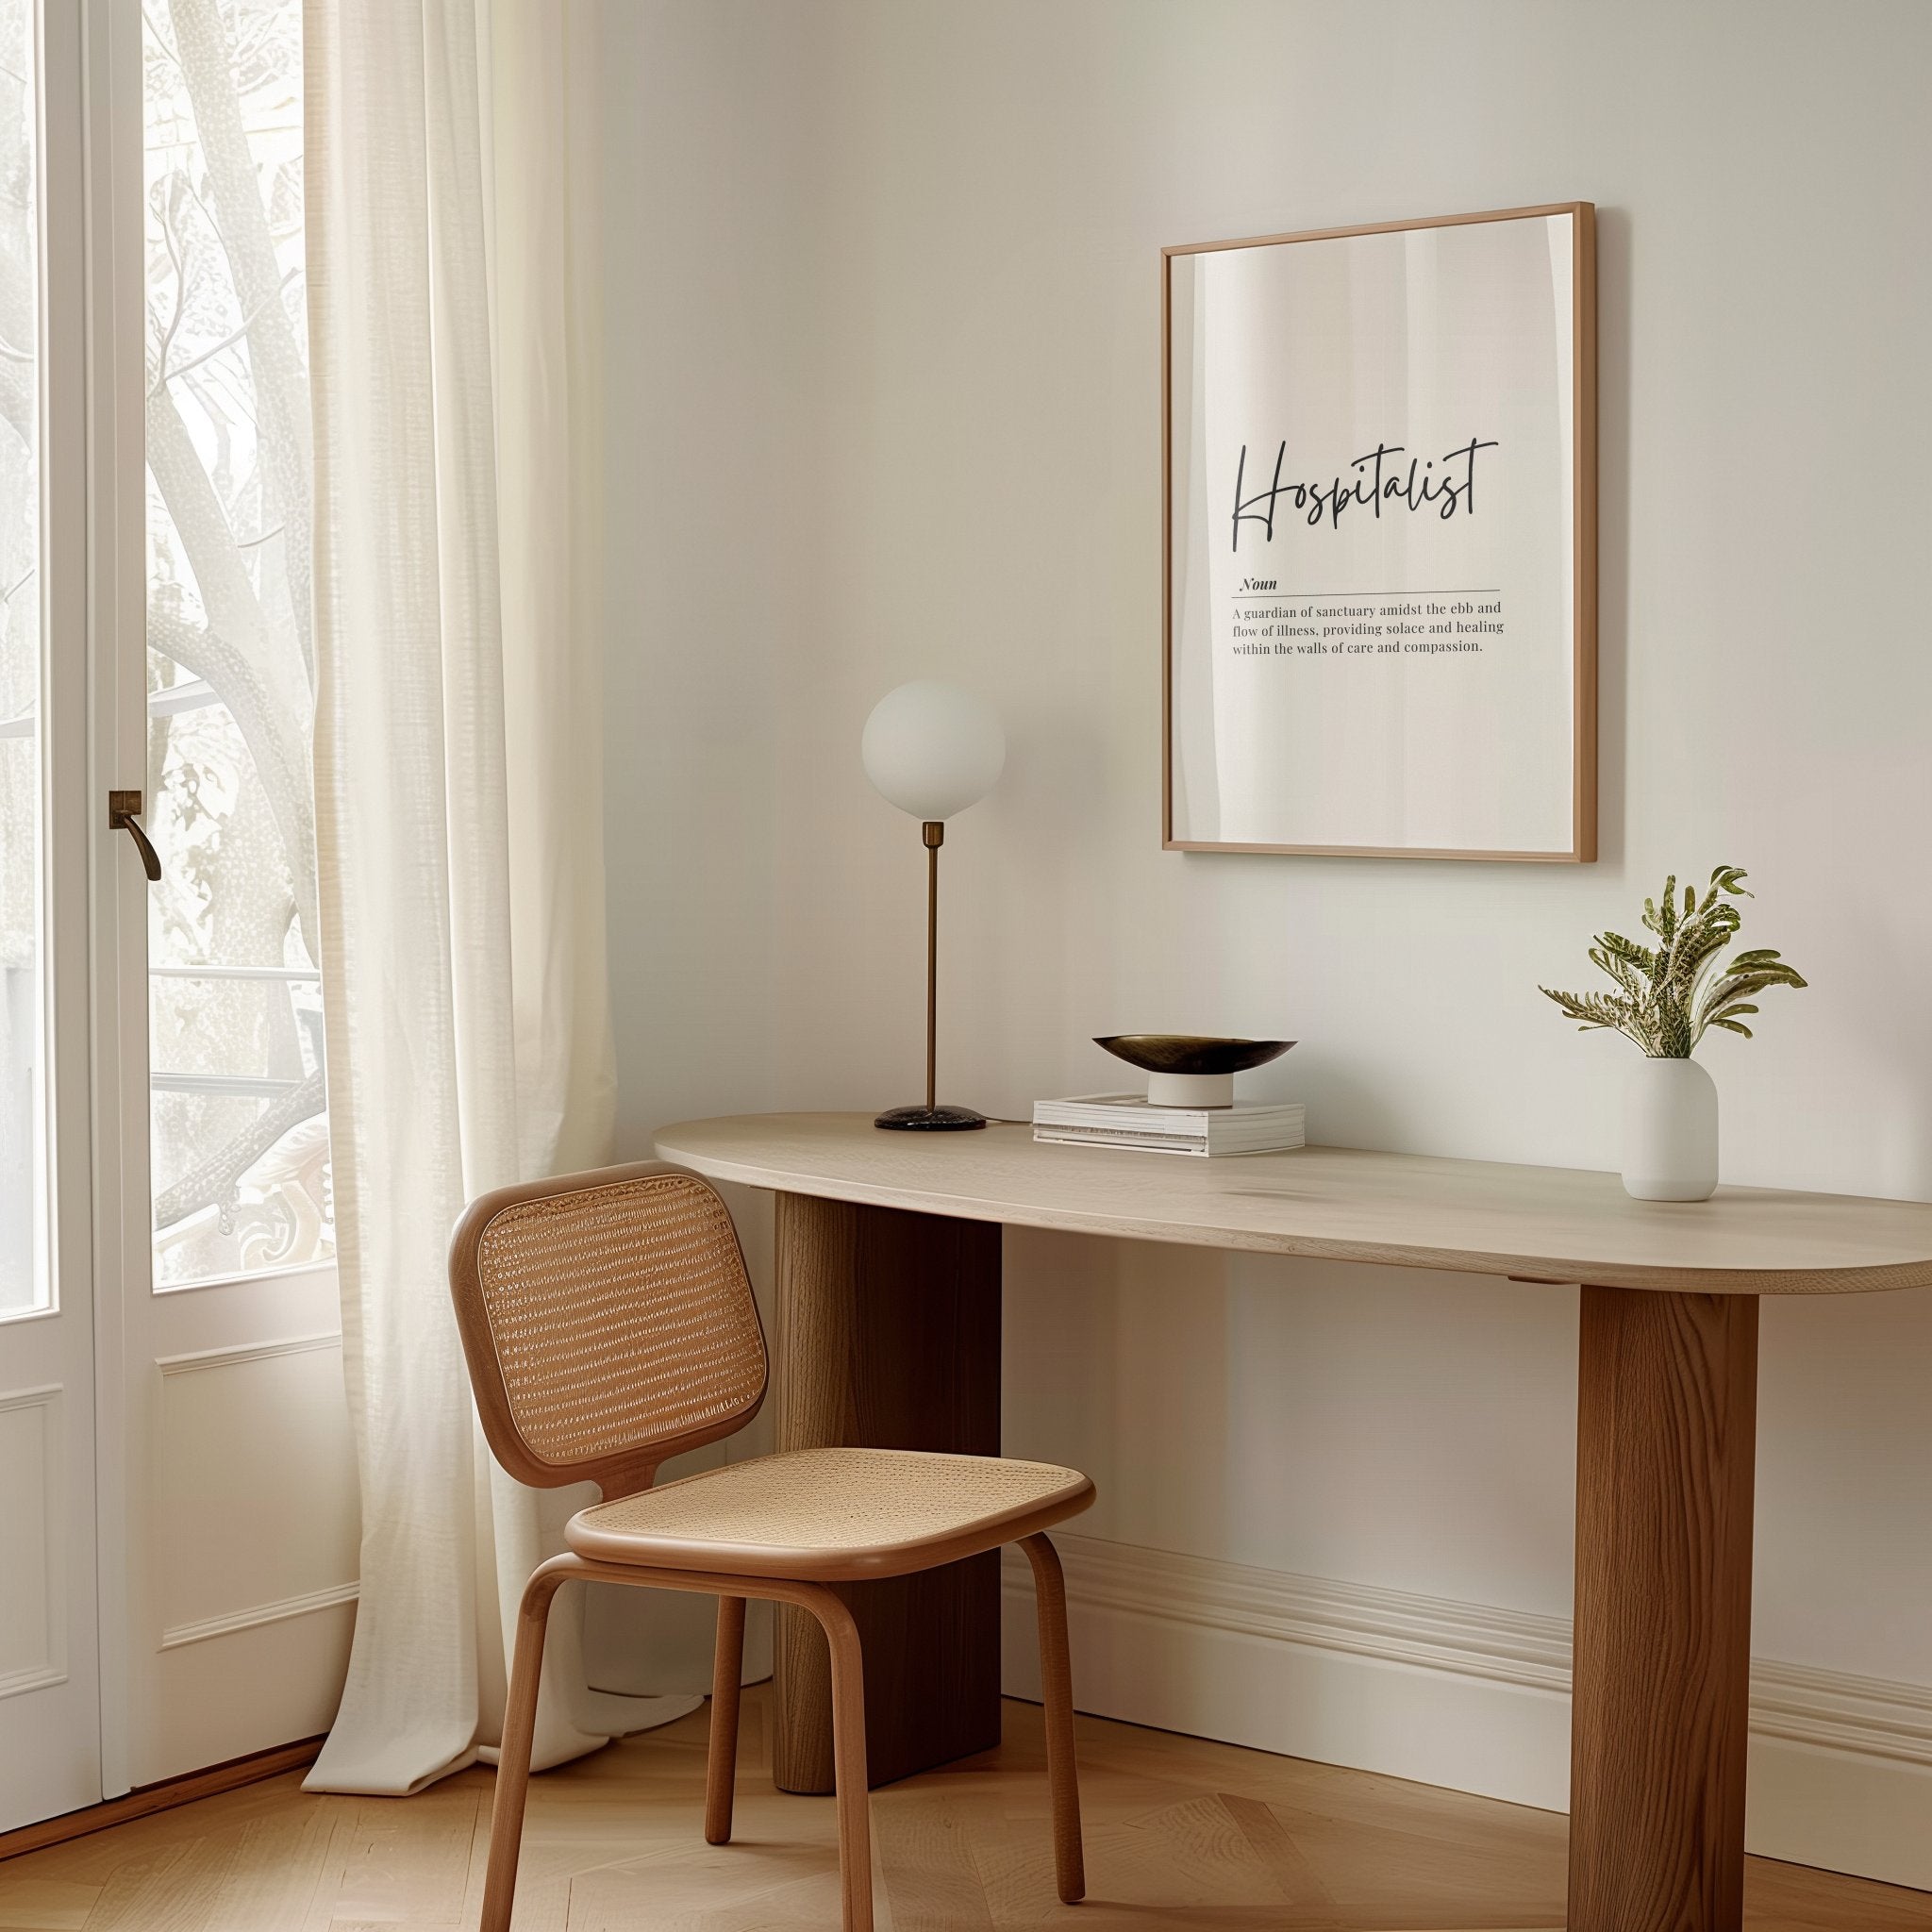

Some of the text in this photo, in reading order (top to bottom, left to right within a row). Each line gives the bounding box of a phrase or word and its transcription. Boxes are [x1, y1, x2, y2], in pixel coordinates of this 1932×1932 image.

[1231, 437, 1499, 553] Hospitalist
[1239, 577, 1277, 591] Noun
[1232, 601, 1502, 621] A guardian of sanctuary amidst the ebb and
[1233, 621, 1505, 638] flow of illness, providing solace and healing
[1232, 641, 1483, 655] within the walls of care and compassion.
